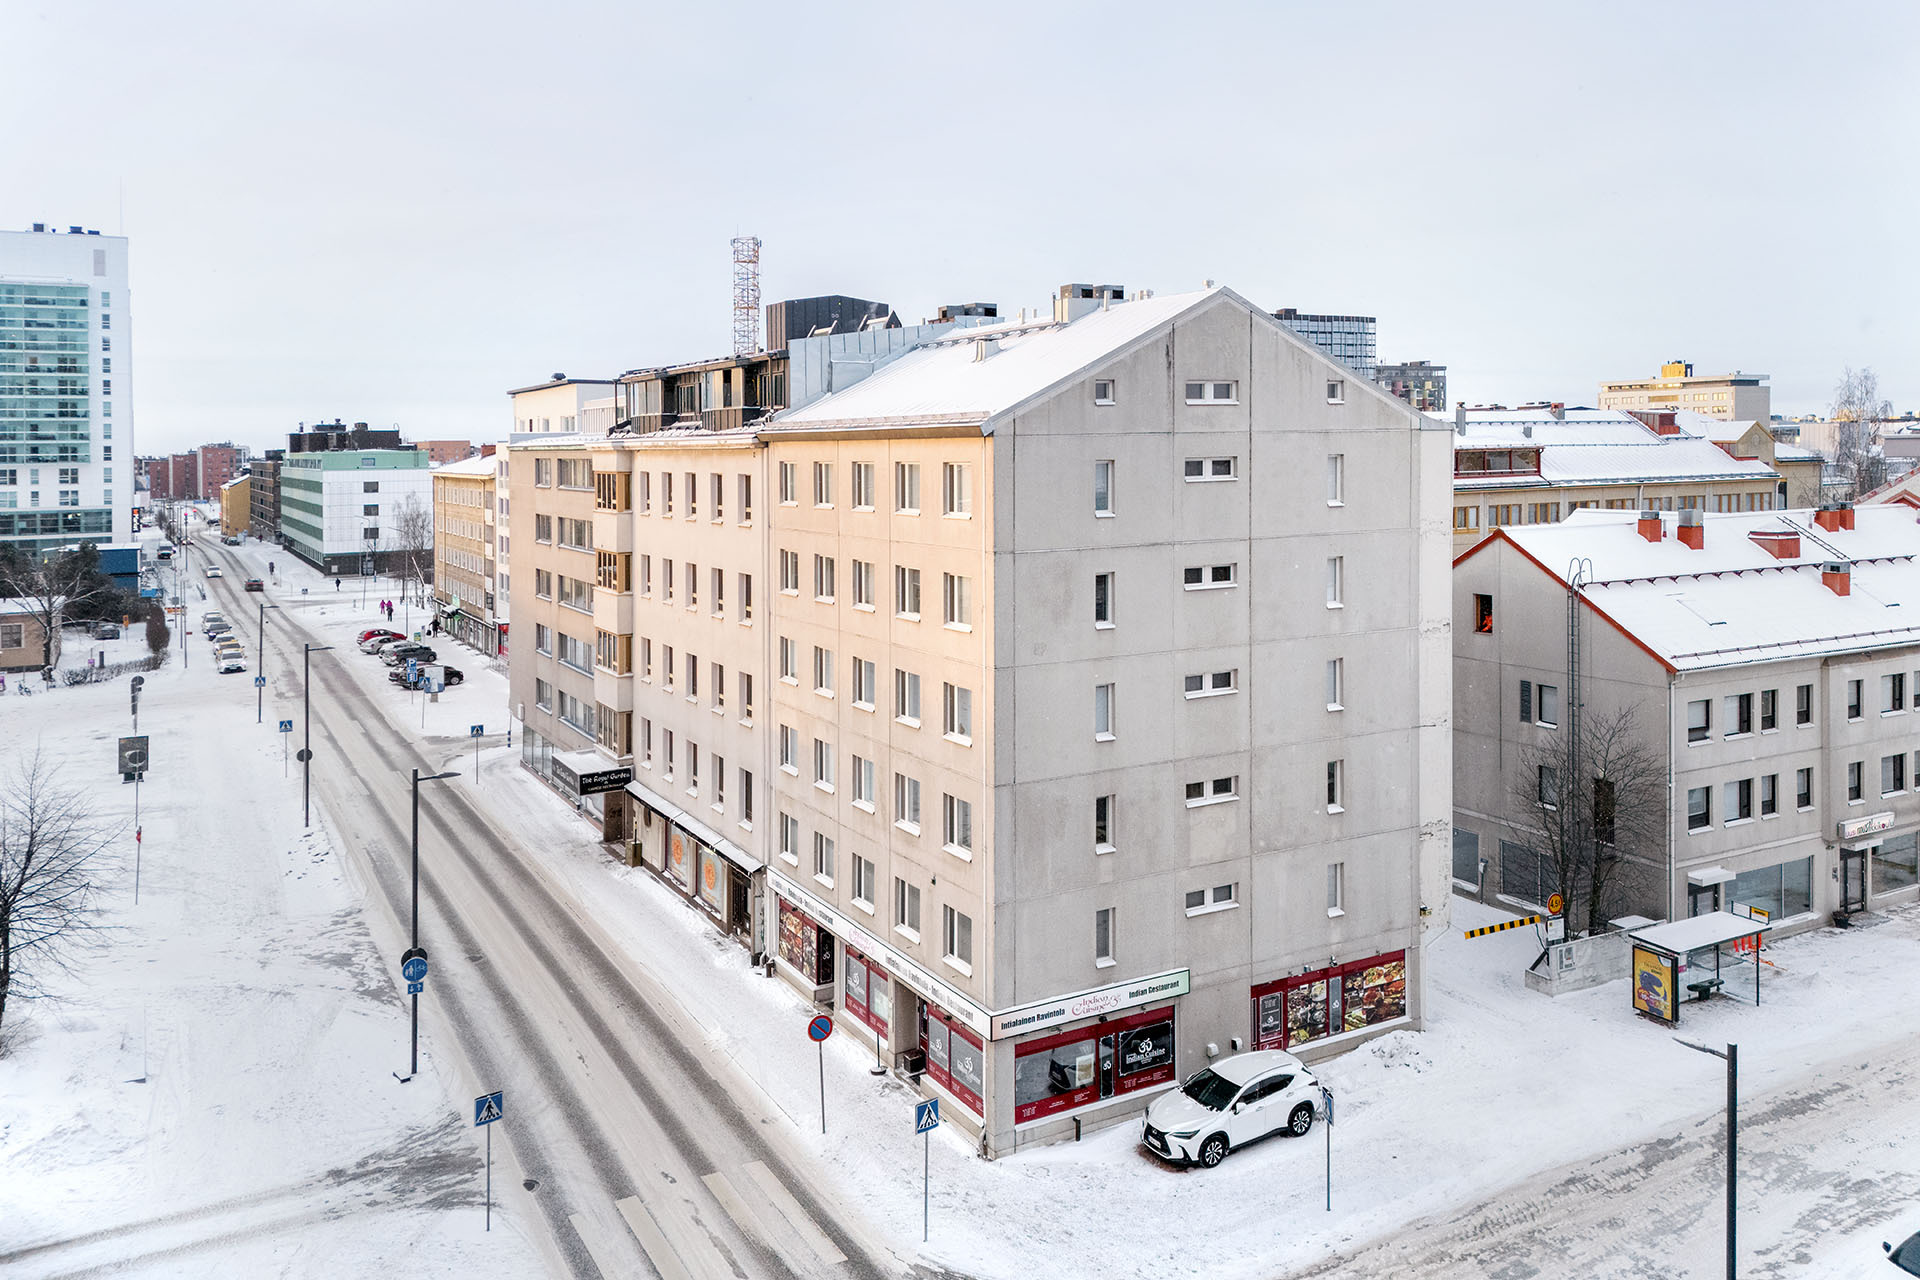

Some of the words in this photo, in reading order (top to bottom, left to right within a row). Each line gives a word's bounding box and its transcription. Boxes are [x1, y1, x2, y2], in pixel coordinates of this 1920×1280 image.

[1128, 988, 1148, 1000] Indian
[1001, 1016, 1036, 1030] Intialainen
[1036, 1008, 1066, 1022] Ravintola
